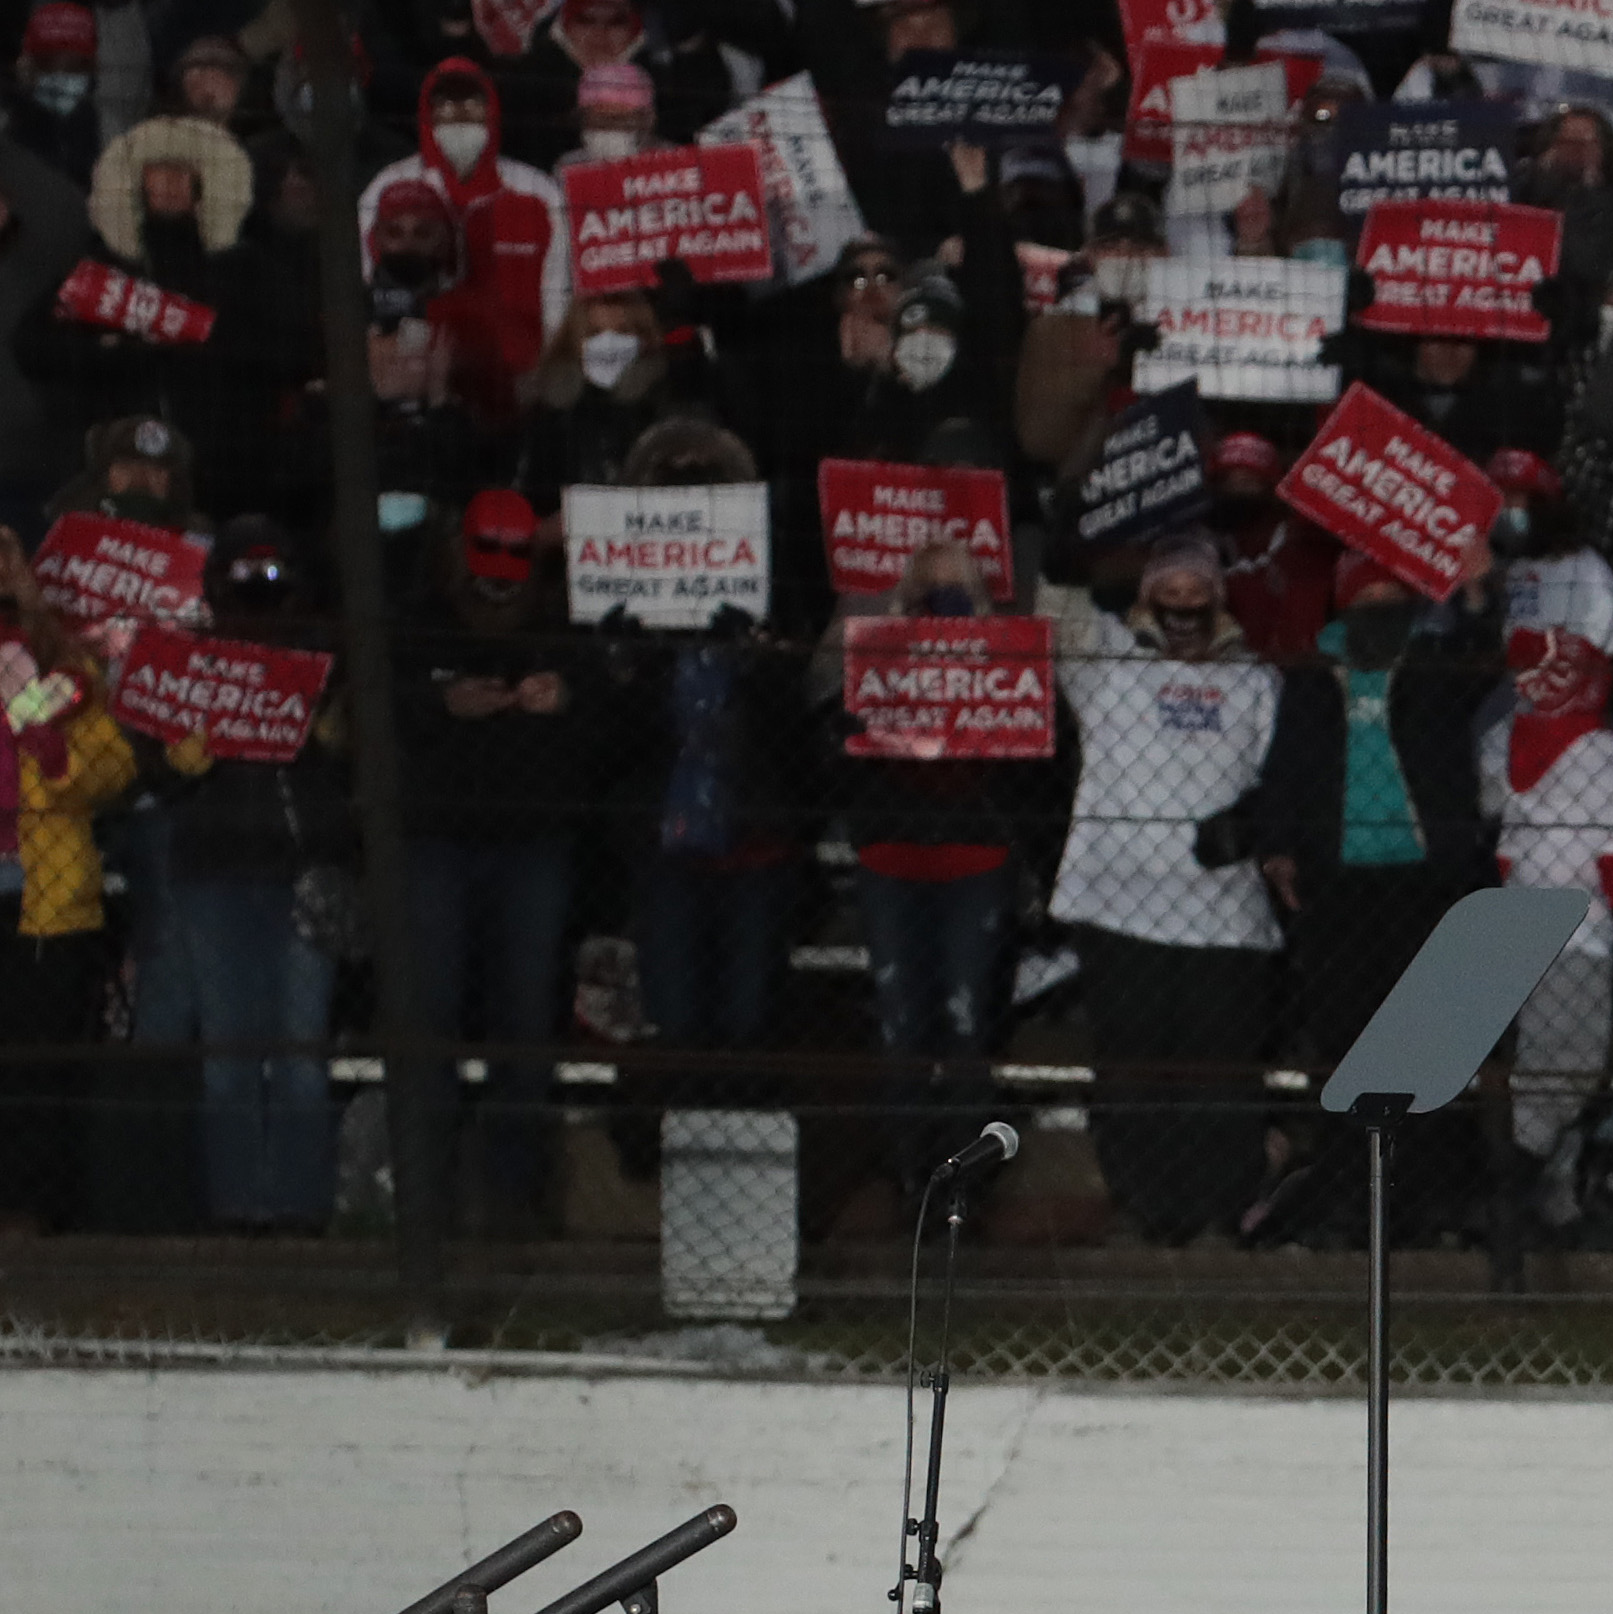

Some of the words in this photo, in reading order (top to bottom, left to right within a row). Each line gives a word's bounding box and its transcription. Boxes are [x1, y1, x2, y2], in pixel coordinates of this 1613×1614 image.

[623, 167, 699, 197] MAKE
[1338, 148, 1509, 185] AMERICA
[577, 191, 759, 244] AMERICA
[580, 236, 669, 273] GREAT
[677, 227, 763, 259] AGAIN
[1383, 435, 1458, 496] MAKE
[1318, 435, 1479, 548] AMERICA
[626, 510, 703, 533] MAKE
[1300, 463, 1385, 525] GREAT
[1380, 520, 1463, 578] AGAIN
[578, 539, 757, 569] AMERICA
[578, 576, 661, 598] GREAT
[671, 574, 759, 598] AGAIN
